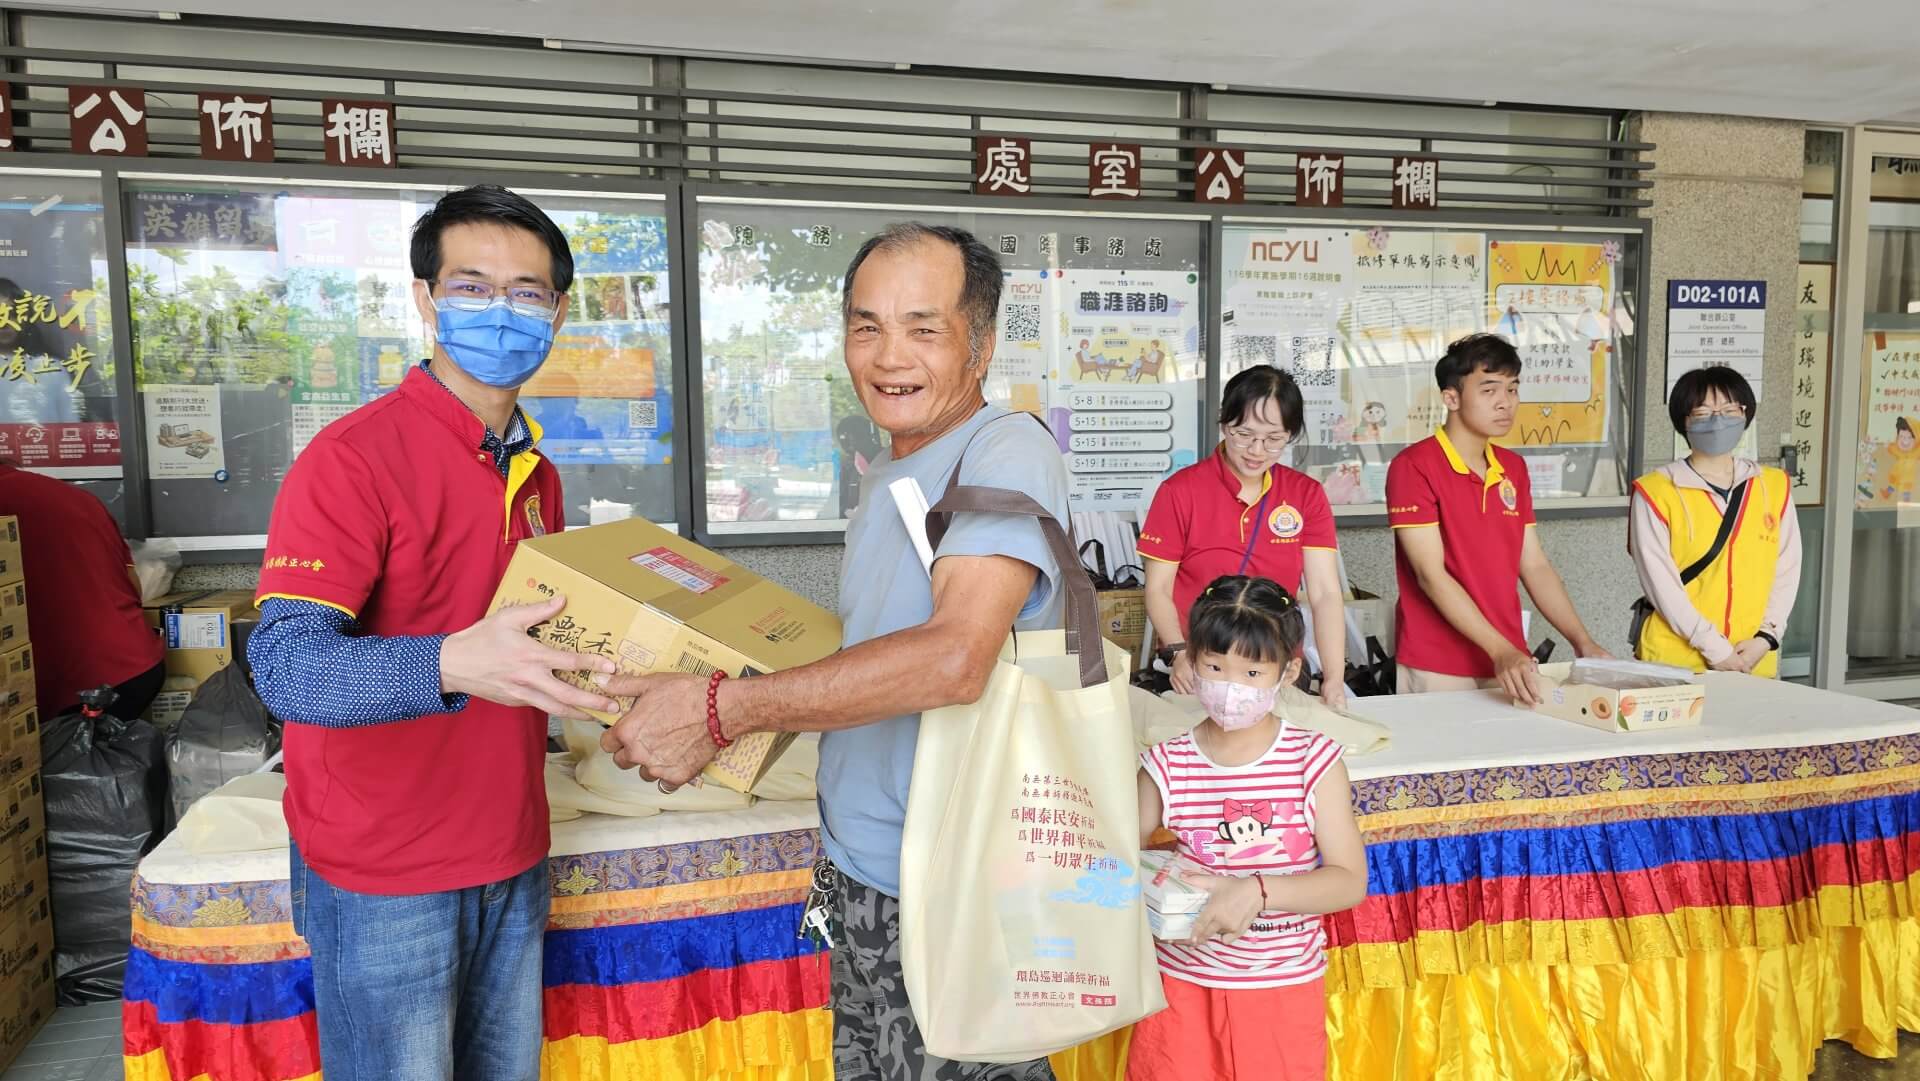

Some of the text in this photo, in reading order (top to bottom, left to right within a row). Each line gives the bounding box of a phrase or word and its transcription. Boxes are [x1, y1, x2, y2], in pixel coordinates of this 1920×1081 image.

[0, 91, 391, 165] 公佈欄
[980, 138, 1436, 206] 處室公佈欄
[1080, 292, 1169, 313] 職涯諮詢
[1677, 285, 1760, 303] D02-101A
[1793, 280, 1817, 488] 友善環境迎師生
